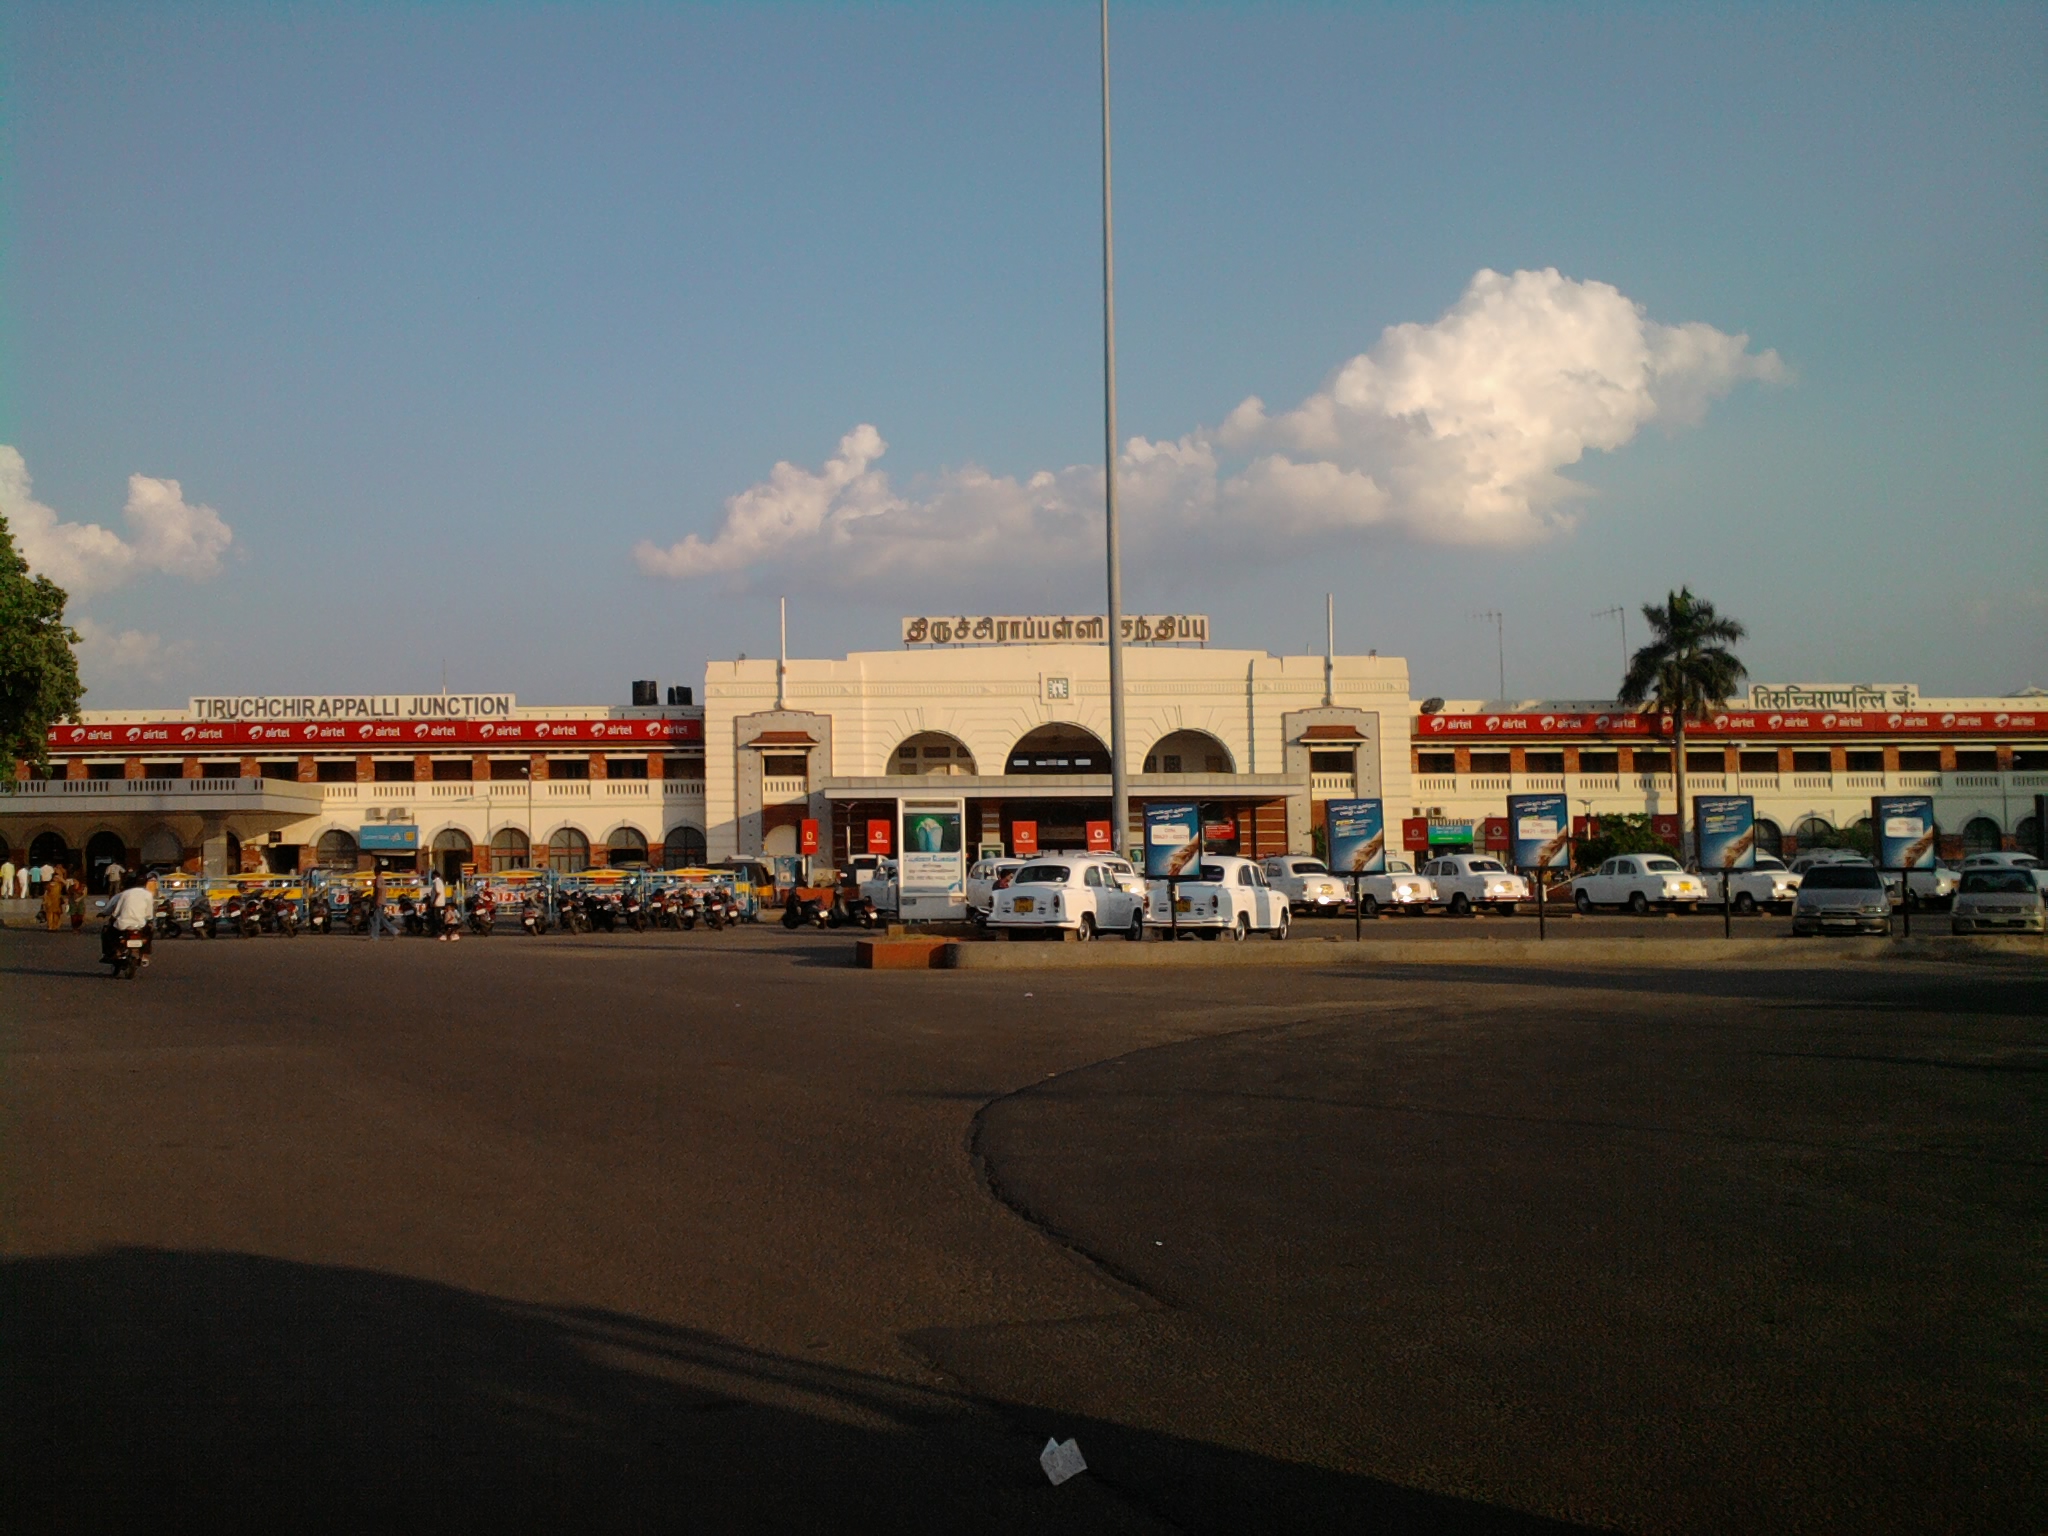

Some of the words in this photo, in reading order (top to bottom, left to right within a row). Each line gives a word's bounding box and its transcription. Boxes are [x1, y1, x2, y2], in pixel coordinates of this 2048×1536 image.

[907, 616, 1104, 643] திருச்சிராப்பள்ளி
[194, 697, 400, 718] TIRUCHCHIRAPPALLI
[407, 696, 510, 716] JUNCTION
[1447, 720, 1472, 729] airtel
[1502, 719, 1527, 729] airtel
[1557, 719, 1582, 729] airtel
[1612, 719, 1636, 728] airtel
[198, 729, 223, 739] airtel
[265, 728, 290, 738] airtel
[320, 727, 345, 737] airtel
[375, 727, 400, 737] airtel
[430, 726, 456, 736] airtel
[496, 726, 521, 736] airtel
[552, 725, 577, 735] airtel
[607, 725, 633, 735] airtel
[663, 725, 688, 734] airtel
[87, 730, 112, 740] airtel
[143, 730, 168, 740] airtel
